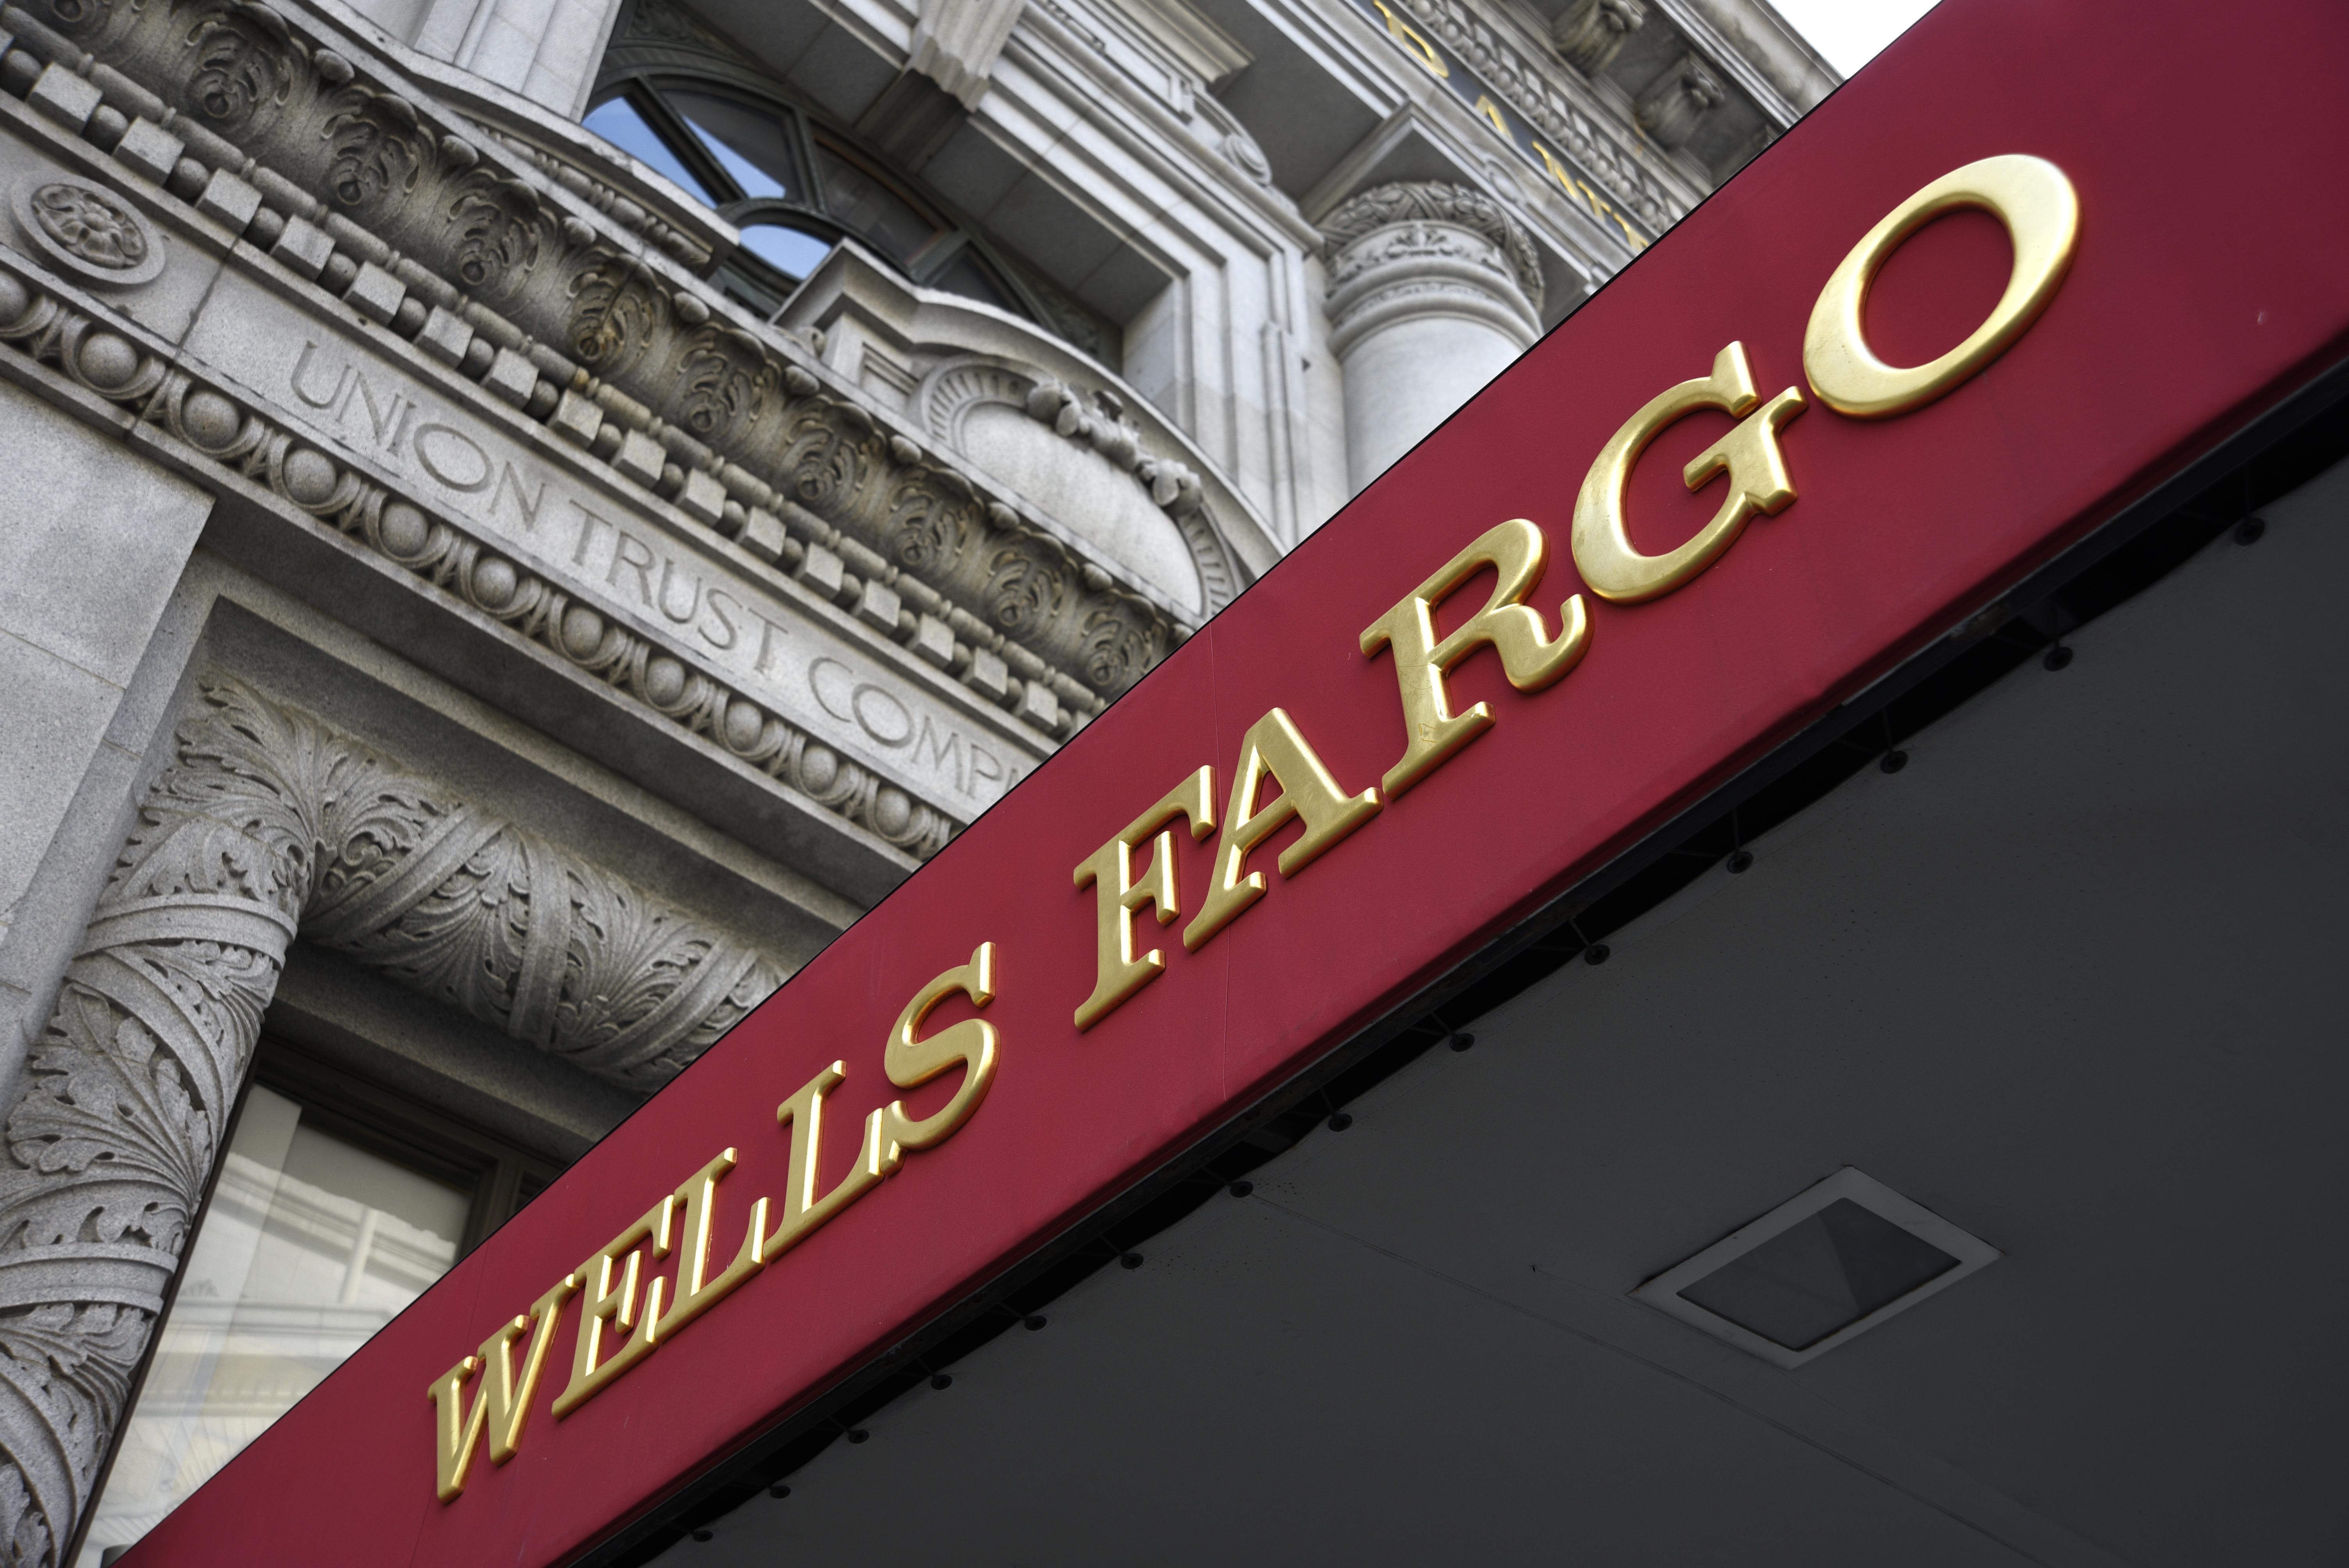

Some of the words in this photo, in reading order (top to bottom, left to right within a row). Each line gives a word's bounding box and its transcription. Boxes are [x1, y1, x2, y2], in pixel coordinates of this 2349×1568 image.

[291, 340, 546, 531] UNION
[569, 499, 788, 675] TRUST
[427, 941, 1001, 1504] WELLS
[1073, 153, 2081, 1032] FARGO
